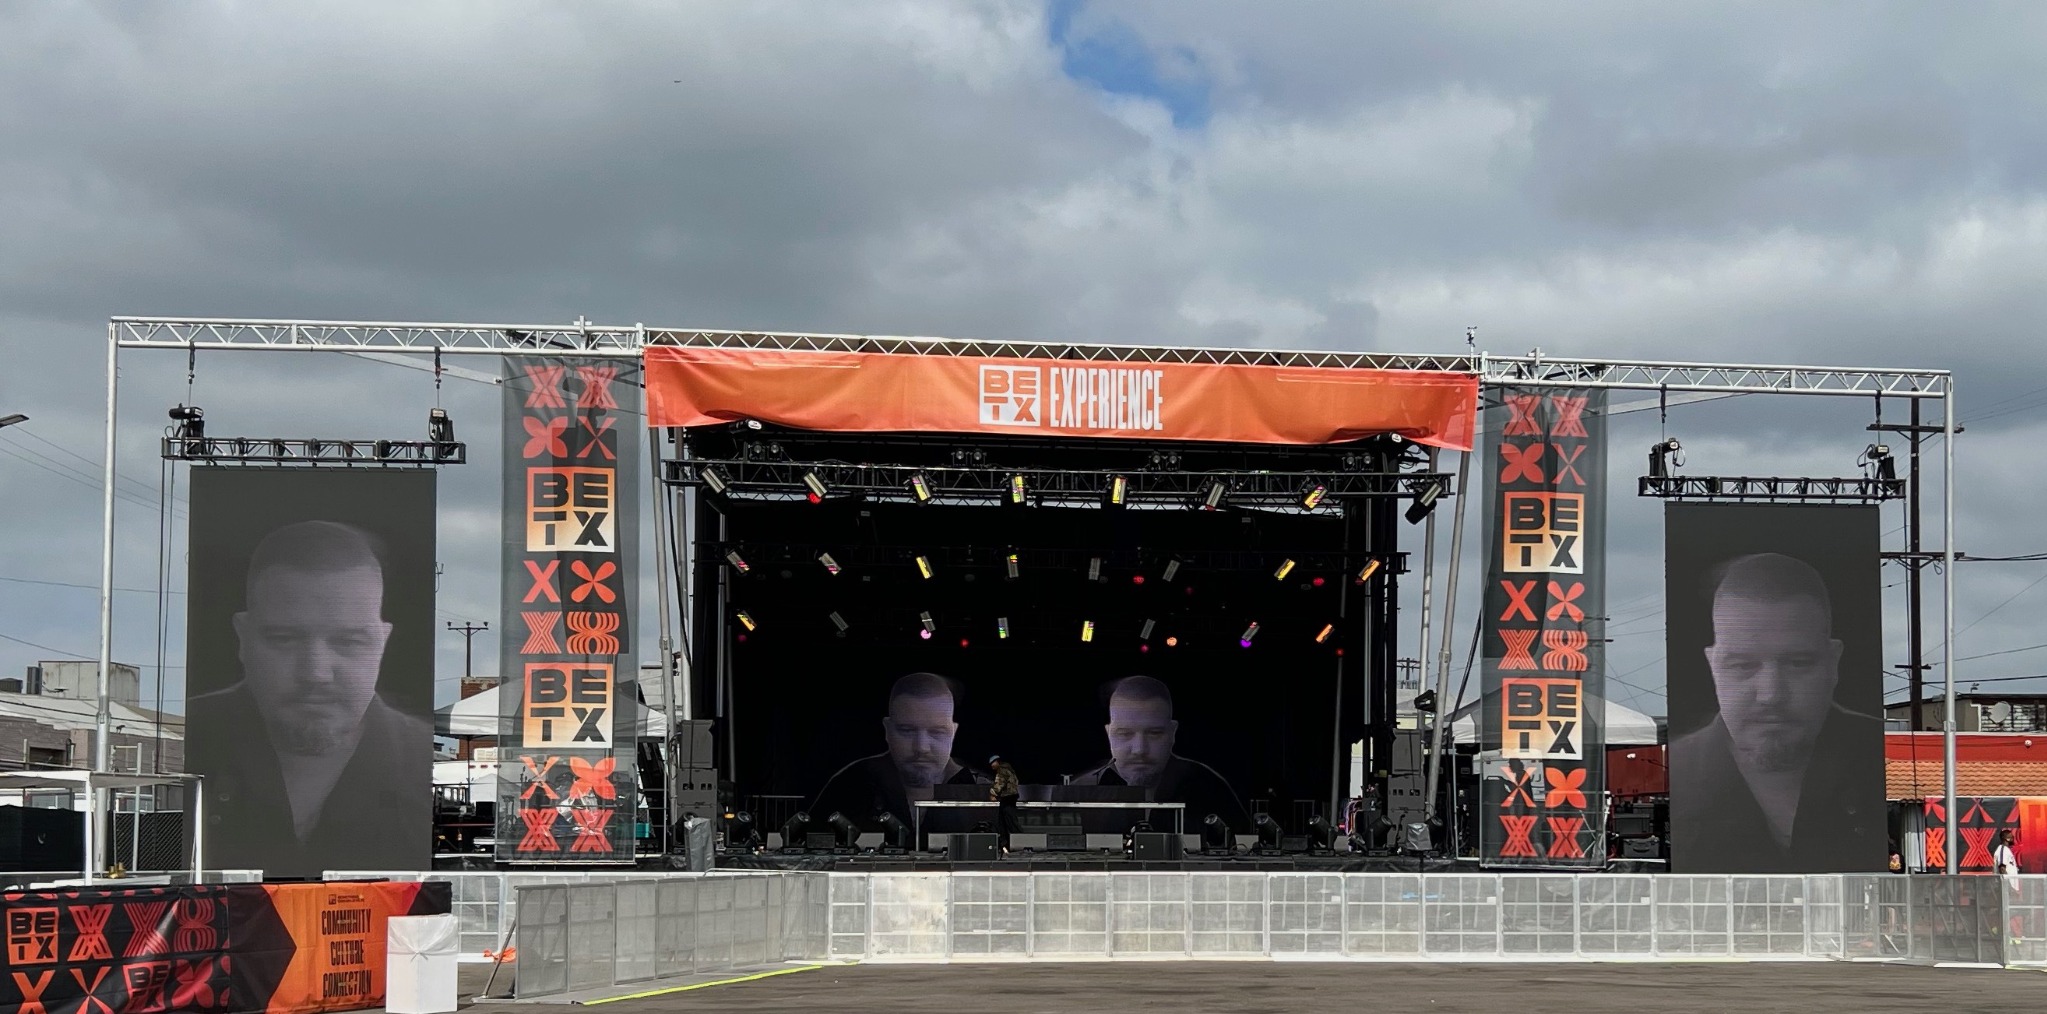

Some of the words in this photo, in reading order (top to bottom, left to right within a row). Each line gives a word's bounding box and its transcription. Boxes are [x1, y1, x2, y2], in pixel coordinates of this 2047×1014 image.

[1050, 367, 1163, 430] EXPERIENCE
[322, 908, 371, 935] COMMUNITY
[331, 940, 364, 965] CULTURE
[323, 970, 372, 998] CONNECTION
